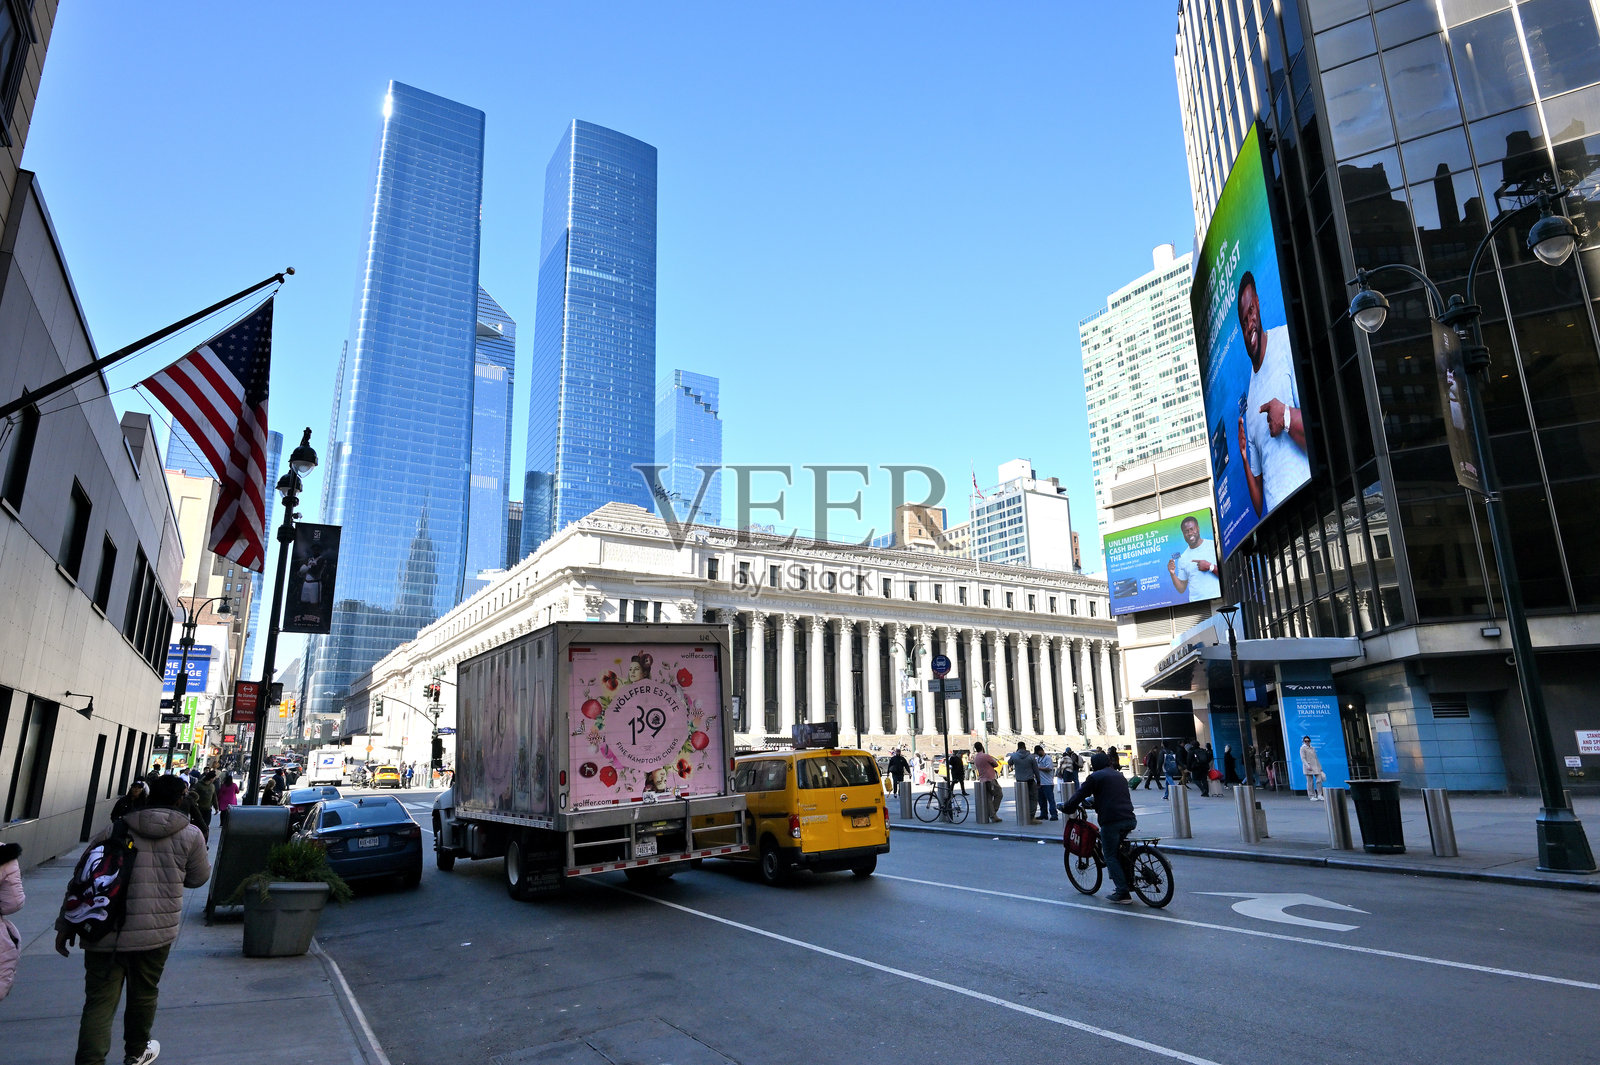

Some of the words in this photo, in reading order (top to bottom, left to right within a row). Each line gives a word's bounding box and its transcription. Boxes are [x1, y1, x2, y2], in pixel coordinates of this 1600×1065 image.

[1225, 239, 1241, 290] JUST
[1108, 533, 1144, 548] UNLIMITED
[1109, 546, 1127, 556] CASH
[1127, 541, 1145, 551] BACK
[1153, 535, 1169, 546] JUST
[1110, 554, 1122, 563] THE
[1122, 545, 1161, 560] BEGINNING
[613, 685, 651, 713] WÖLFFER
[653, 687, 680, 713] ESTATE
[616, 741, 628, 756] FINE
[627, 753, 662, 764] HAMPTONS
[661, 737, 679, 758] CIDERS
[573, 799, 612, 808] wolffer.com
[1070, 828, 1080, 845] GH
